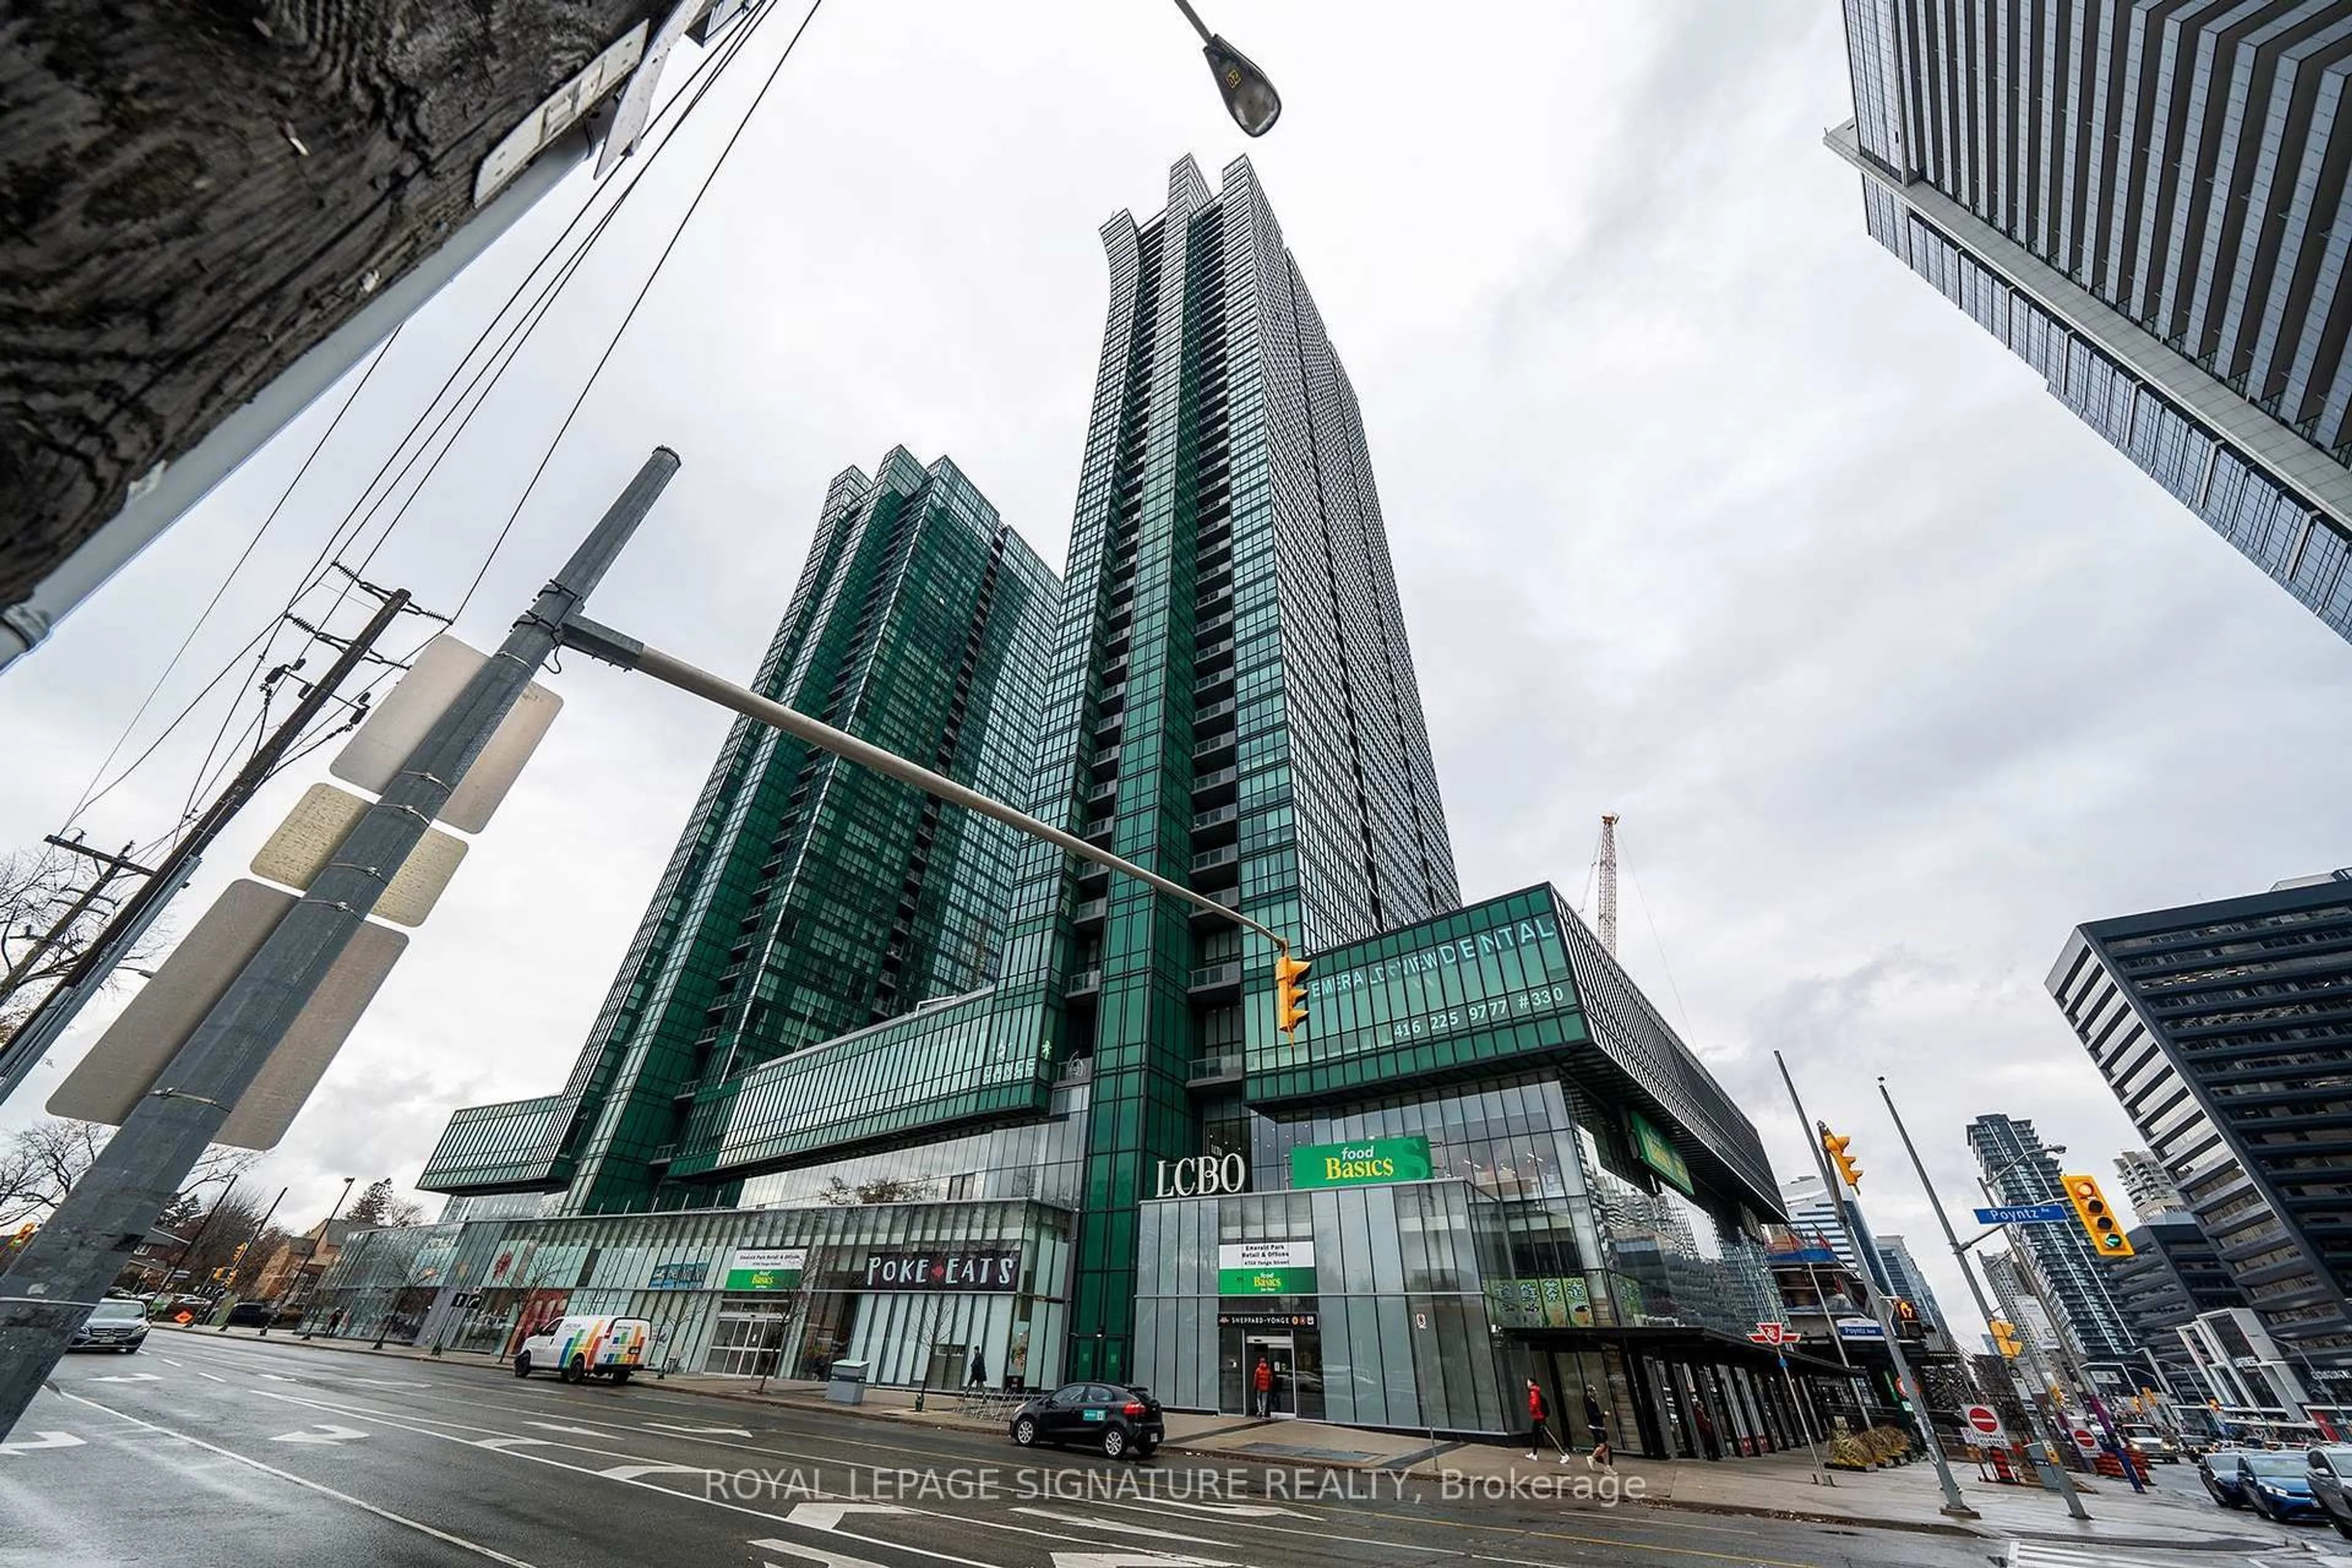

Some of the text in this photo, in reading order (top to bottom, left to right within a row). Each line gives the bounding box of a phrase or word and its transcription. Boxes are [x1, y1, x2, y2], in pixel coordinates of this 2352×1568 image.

[1439, 919, 1554, 964] DENTAL
[1394, 987, 1564, 1037] 416 225 9777 #330
[1341, 1145, 1374, 1159] food
[1156, 1153, 1245, 1197] LCBO
[1989, 1208, 2040, 1221] Poyntz
[867, 1257, 1014, 1286] POKE EATS
